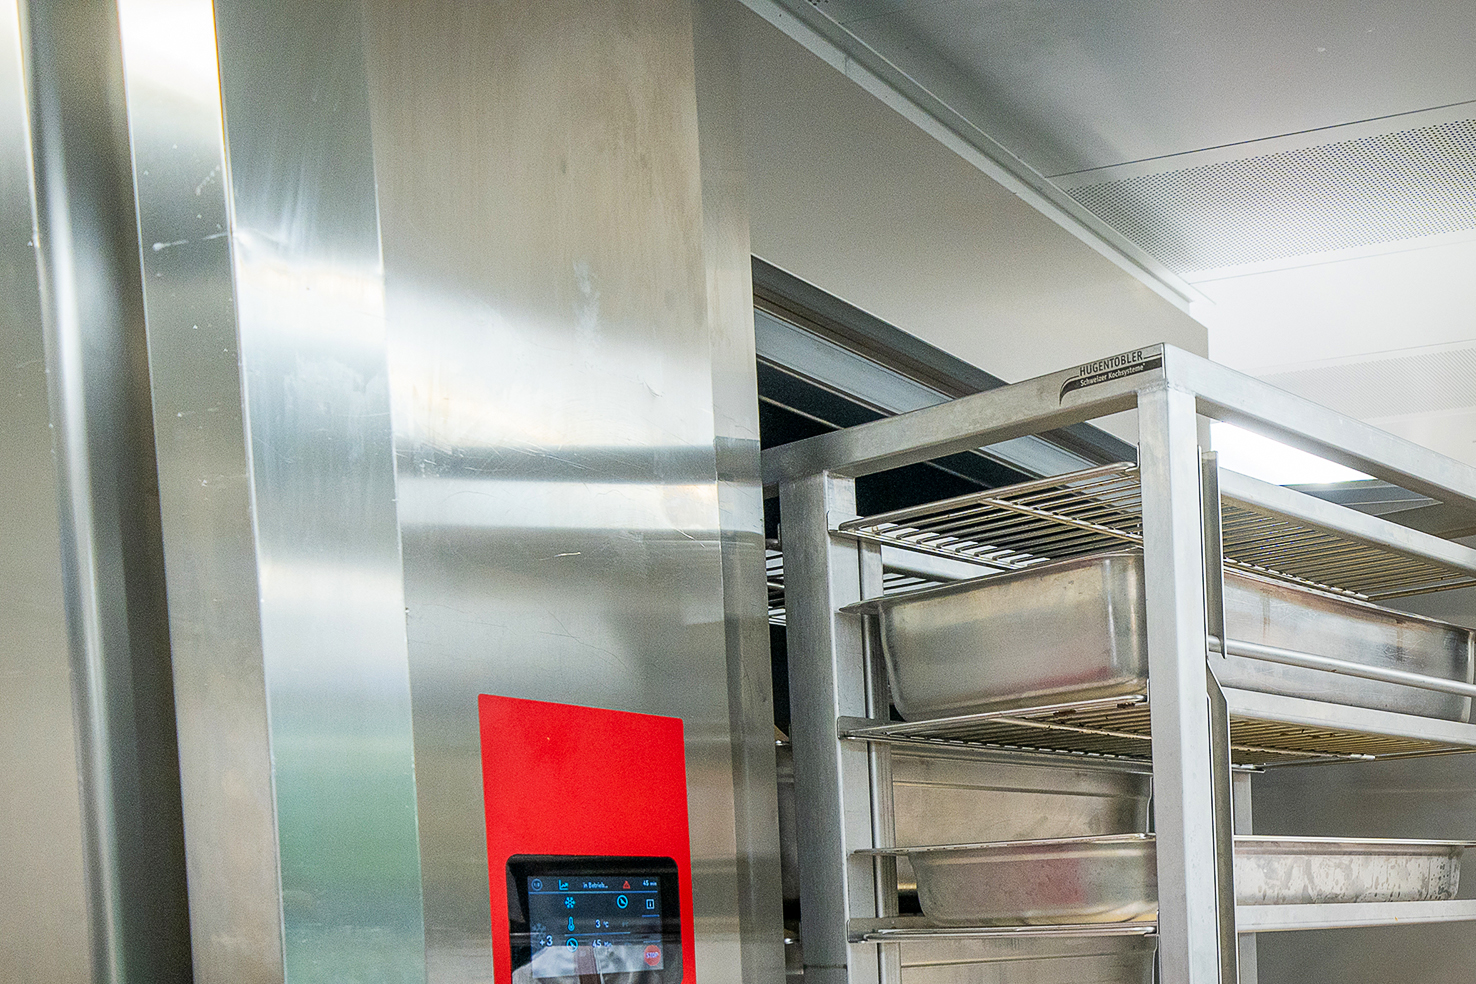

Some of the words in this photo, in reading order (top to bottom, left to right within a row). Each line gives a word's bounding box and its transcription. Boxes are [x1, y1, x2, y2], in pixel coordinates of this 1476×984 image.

[1079, 350, 1143, 377] HUGENTOBLER
[1080, 374, 1107, 387] Schweizer
[595, 918, 601, 929] 3
[645, 951, 659, 959] STOP
